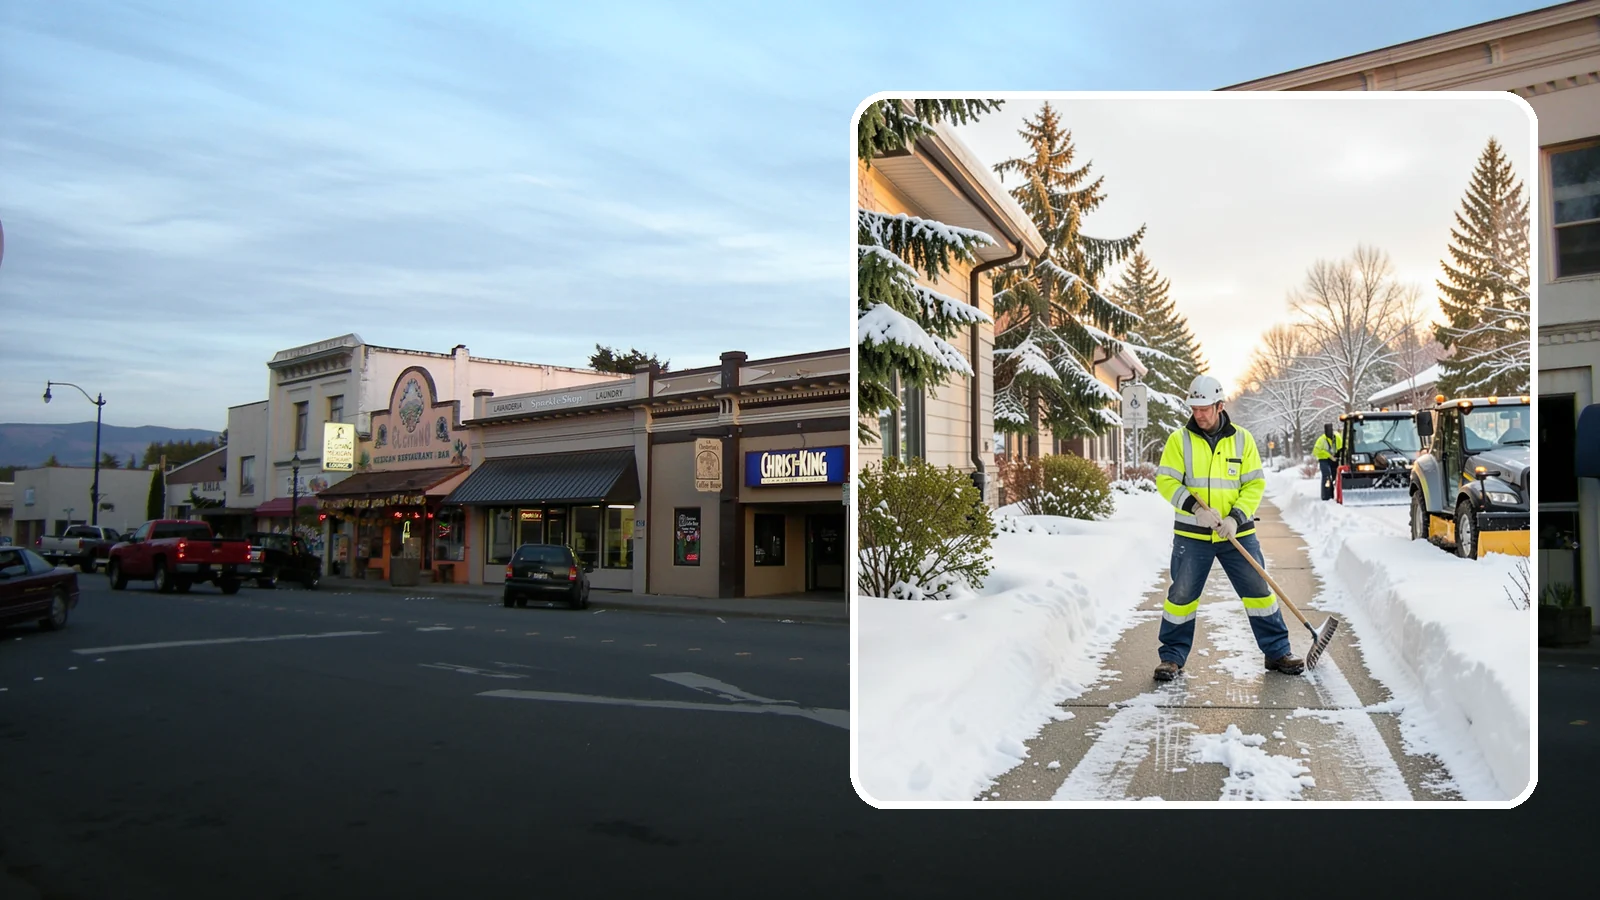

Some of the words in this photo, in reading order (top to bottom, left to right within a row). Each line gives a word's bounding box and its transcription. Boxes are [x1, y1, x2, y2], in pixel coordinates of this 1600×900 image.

[493, 402, 523, 413] LAVANDERIA
[530, 398, 561, 409] Sparkle
[562, 395, 583, 405] Shop
[595, 389, 623, 400] LAUNDRY
[373, 456, 396, 464] MEXICAN
[397, 452, 434, 463] RESTAURANT
[438, 450, 450, 459] BAR
[760, 452, 798, 478] CHRIST
[799, 450, 828, 477] KING
